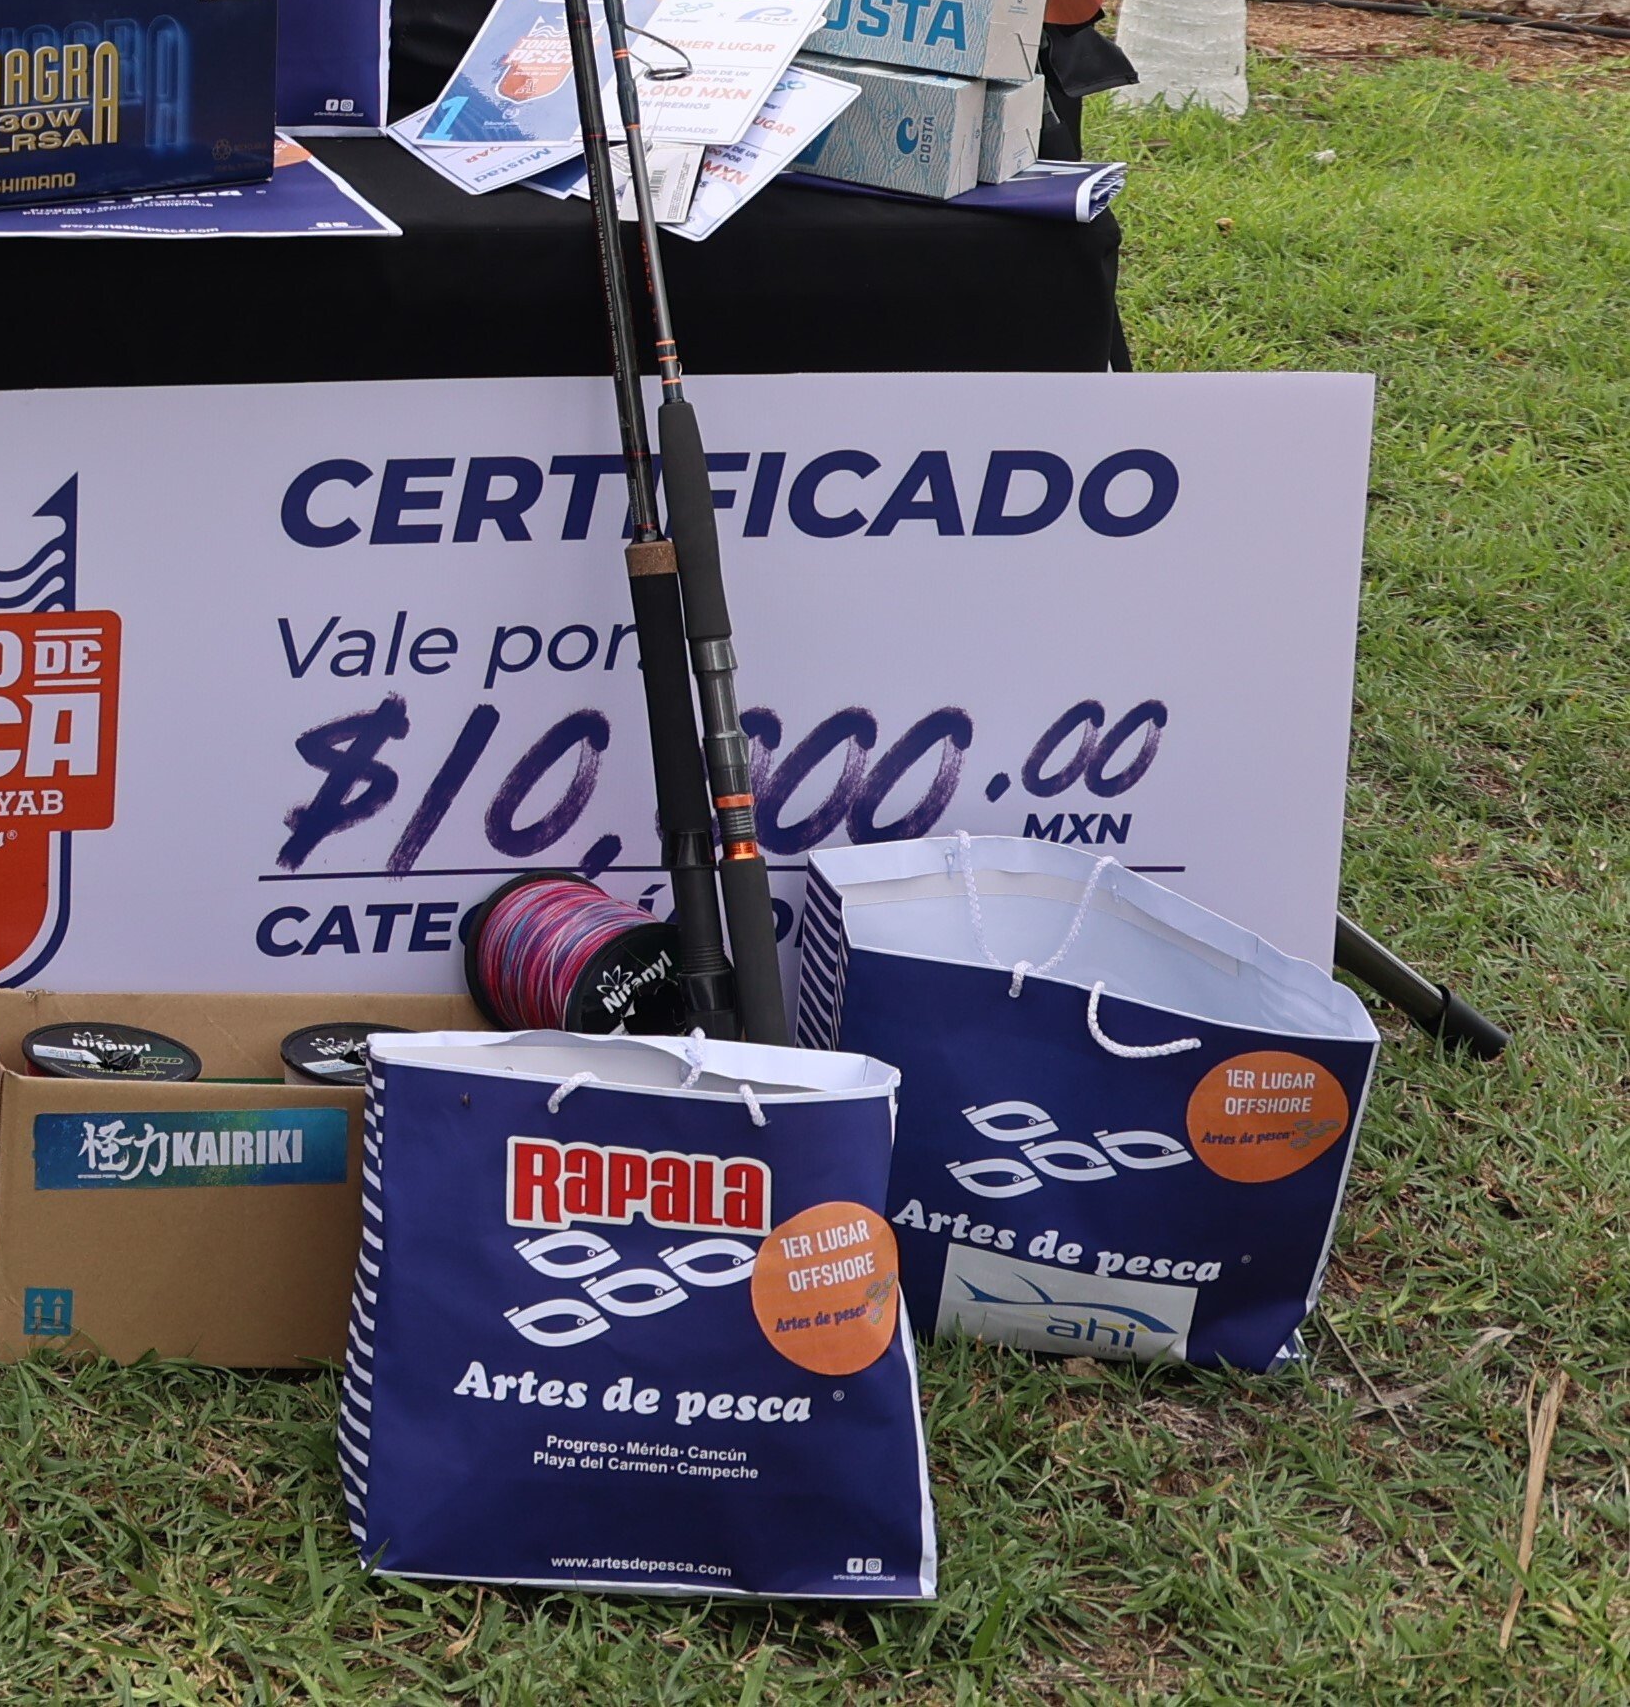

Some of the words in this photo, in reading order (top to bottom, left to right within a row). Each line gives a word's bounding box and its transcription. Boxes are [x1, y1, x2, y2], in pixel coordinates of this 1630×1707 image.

[718, 42, 776, 53] LUGAR
[658, 101, 711, 110] PREMIOS
[699, 86, 751, 100] MXN
[919, 114, 936, 166] COSTA
[472, 147, 551, 182] Mustad
[34, 637, 102, 675] DE
[276, 611, 459, 680] Vale
[1022, 812, 1132, 844] MXN
[1225, 1068, 1256, 1090] 1ER
[1261, 1068, 1317, 1092] LUGAR
[1223, 1095, 1313, 1116] OFFSHORE
[171, 1129, 304, 1167] KAIRIKI
[779, 1234, 813, 1260] 1ER
[817, 1219, 871, 1253] LUGAR
[891, 1198, 1017, 1252] Artes
[1028, 1230, 1083, 1266] de
[1094, 1246, 1223, 1284] pesca
[787, 1251, 877, 1294] OFFSHORE
[1045, 1312, 1137, 1348] ahi
[453, 1360, 589, 1410] Artes
[602, 1376, 660, 1415] de
[675, 1388, 813, 1425] pesca
[533, 1452, 578, 1471] Playa
[579, 1455, 605, 1470] del
[687, 1444, 748, 1462] Cancún
[551, 1555, 733, 1577] www.artesdepesca.com
